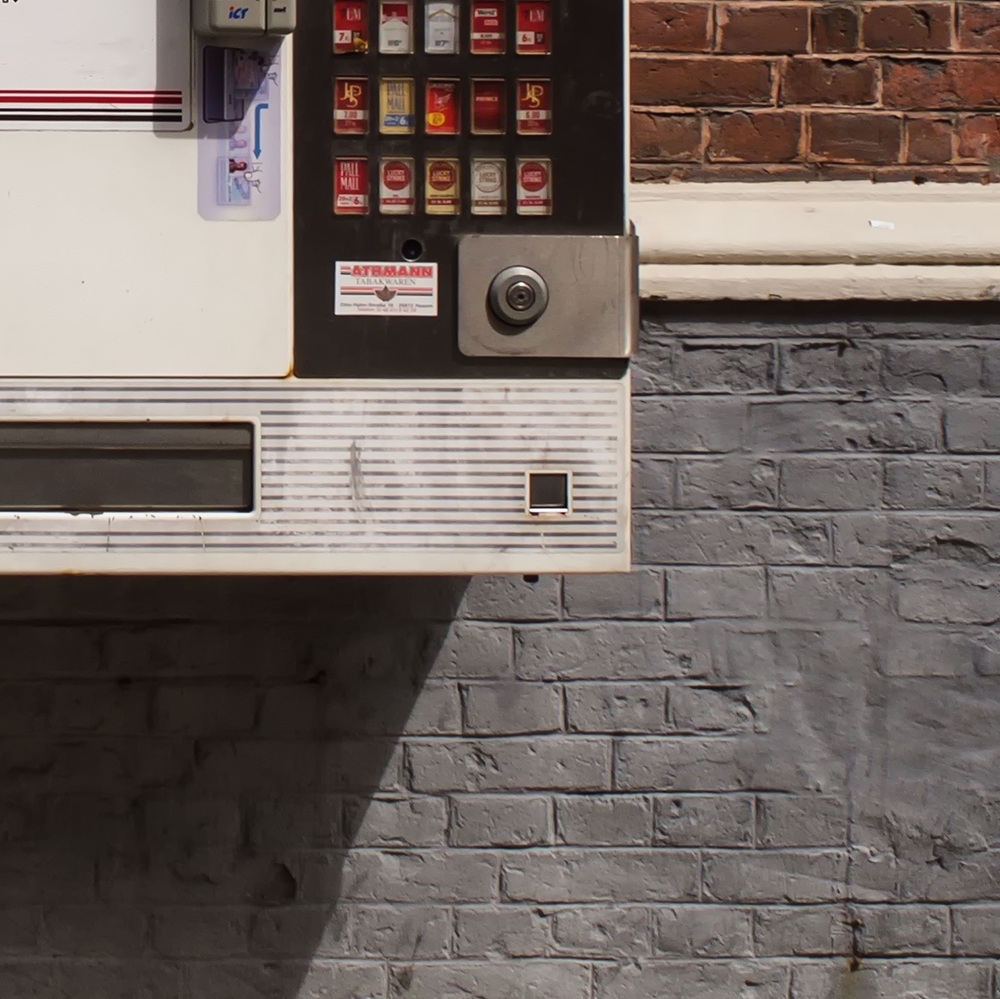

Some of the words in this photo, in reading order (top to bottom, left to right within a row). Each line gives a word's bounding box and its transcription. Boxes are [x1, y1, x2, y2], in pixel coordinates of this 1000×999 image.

[340, 162, 359, 177] PALL
[340, 176, 359, 191] MALL
[351, 265, 433, 278] ATHMANN
